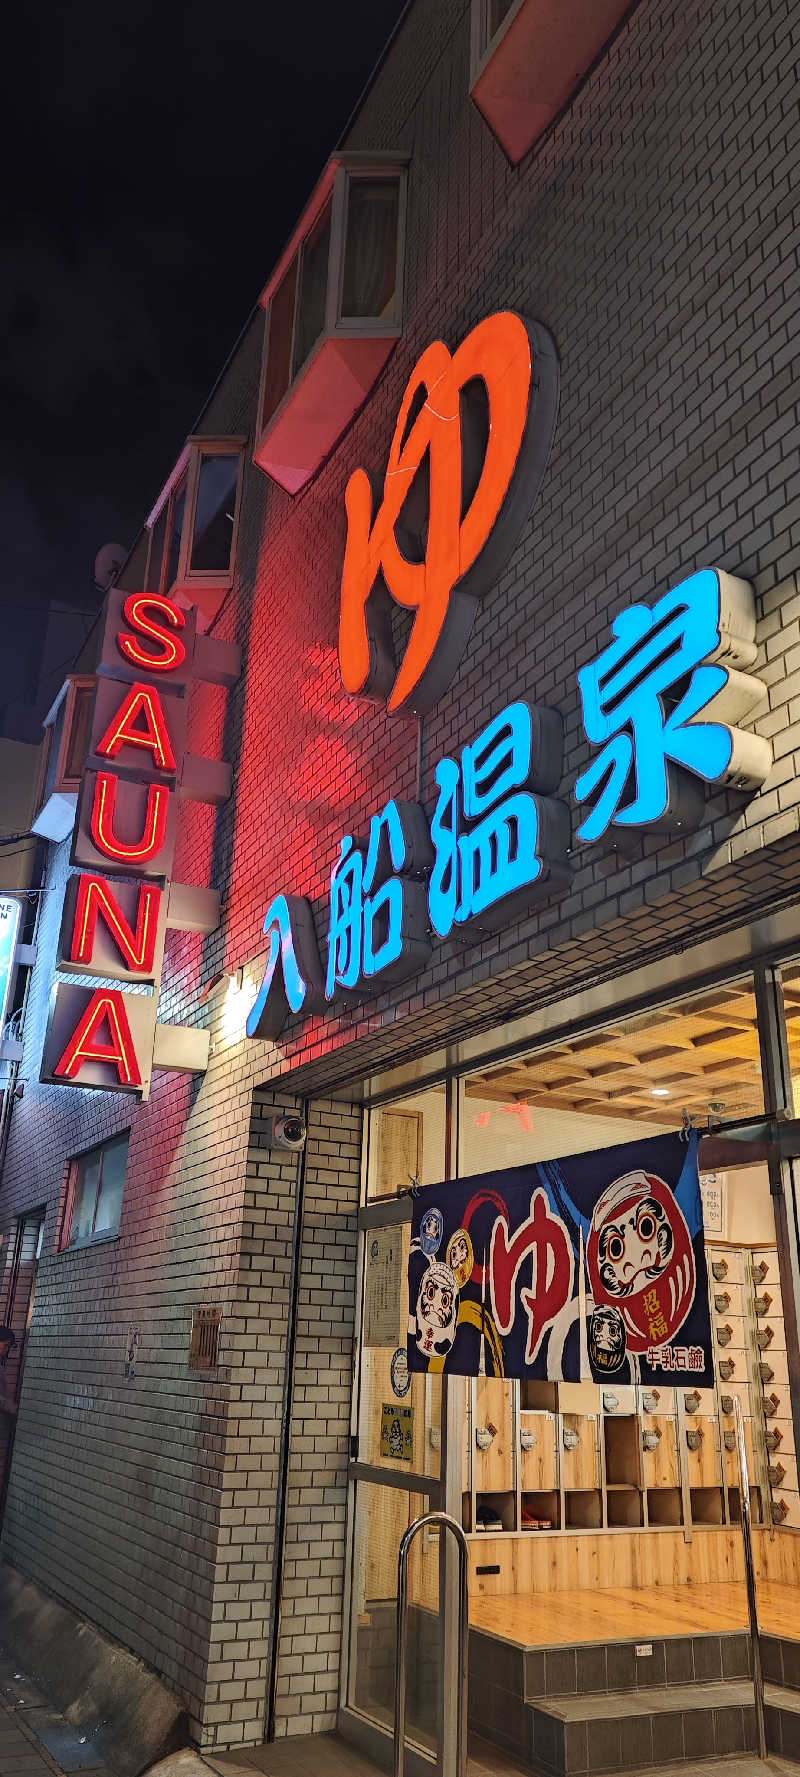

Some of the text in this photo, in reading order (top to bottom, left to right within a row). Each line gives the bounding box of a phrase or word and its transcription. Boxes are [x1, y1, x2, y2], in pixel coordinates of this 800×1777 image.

[339, 310, 531, 712] ゆ
[53, 591, 187, 1088] SAUNA
[246, 566, 735, 1037] 入船温泉
[491, 1189, 574, 1363] ゆ
[643, 1289, 668, 1341] 招福
